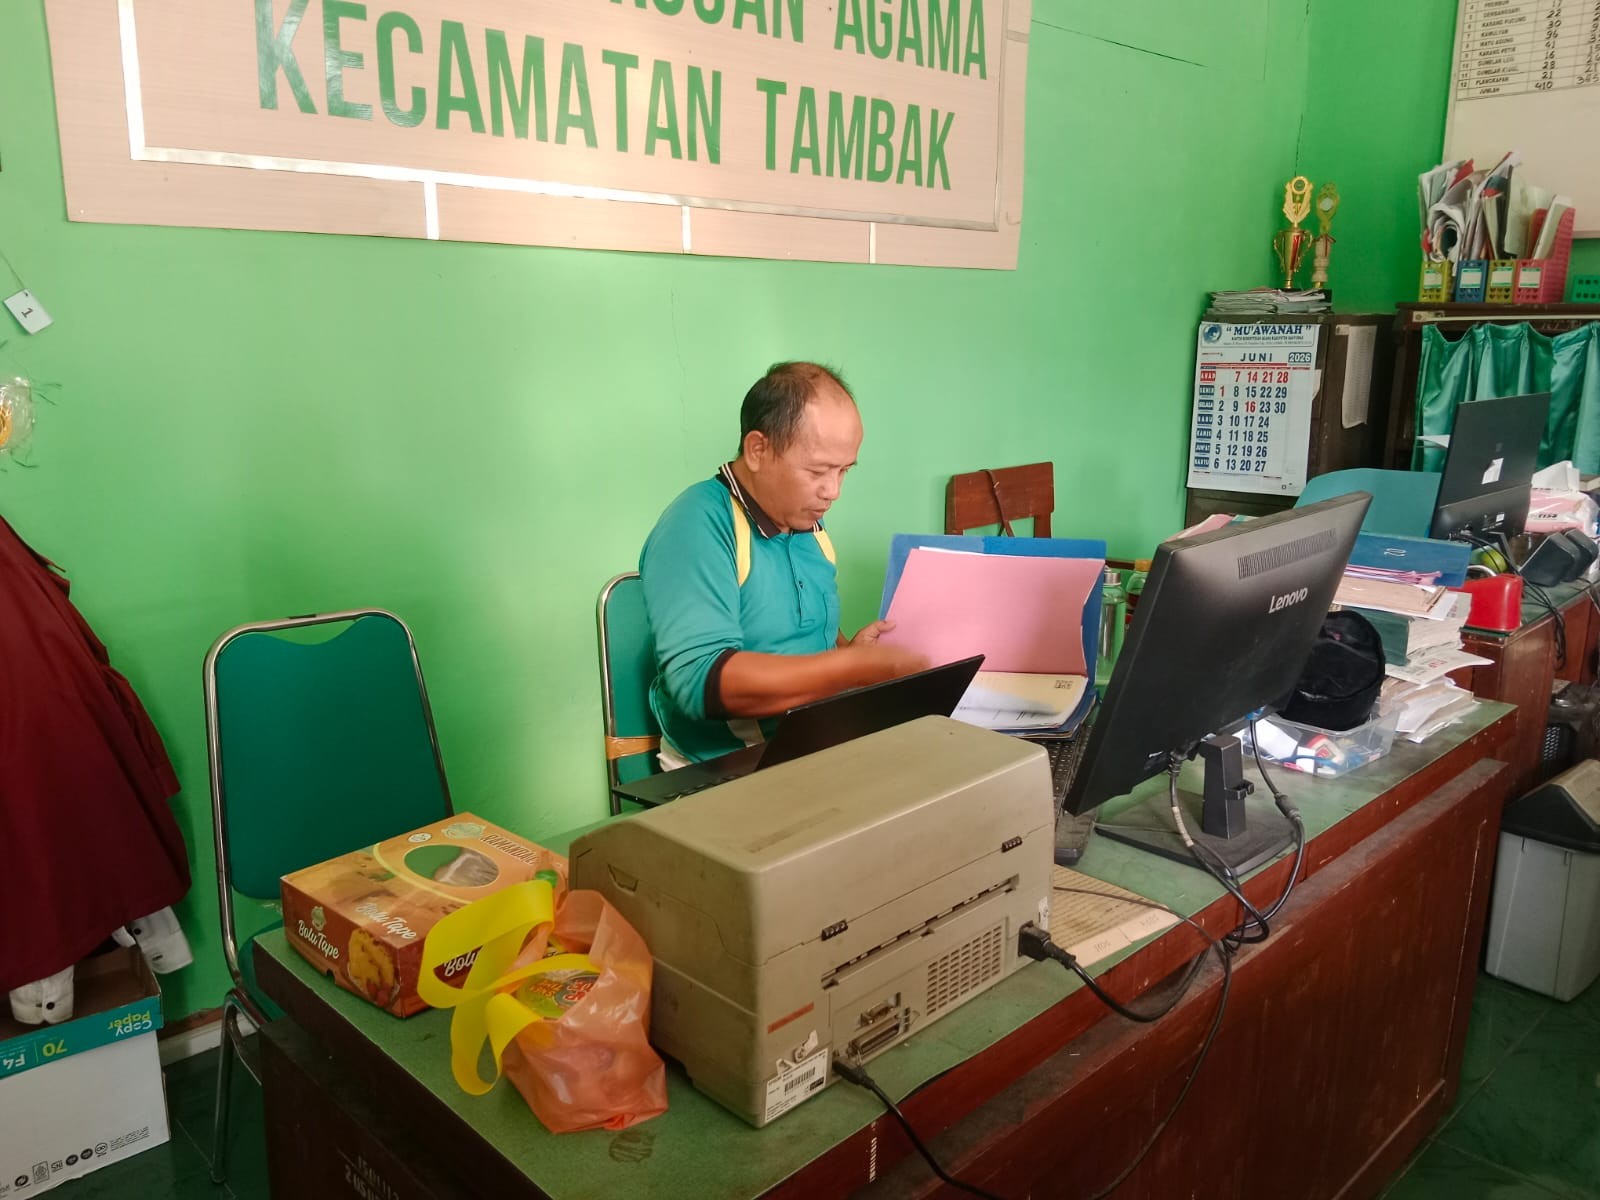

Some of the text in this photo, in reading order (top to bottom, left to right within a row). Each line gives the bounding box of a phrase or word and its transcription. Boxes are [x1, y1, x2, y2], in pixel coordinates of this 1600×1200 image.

[834, 0, 987, 80] AGAMA
[254, 0, 955, 191] KECAMATAN TAMBAK
[1240, 352, 1312, 362] JUNI 2026
[1235, 371, 1240, 383] 7
[1248, 371, 1258, 383] 14
[1262, 372, 1273, 383] 21
[1277, 372, 1288, 383] 28
[1220, 386, 1224, 397] 1
[1234, 386, 1239, 397] 8
[1246, 386, 1256, 398] 15
[1260, 387, 1271, 398] 22
[1275, 387, 1287, 398] 29
[1218, 400, 1224, 412] 2
[1233, 401, 1238, 412] 9
[1245, 401, 1256, 413] 16
[1259, 402, 1270, 413] 23
[1274, 402, 1286, 414] 30
[1217, 415, 1223, 426] 3
[1230, 415, 1240, 427] 10
[1244, 416, 1254, 427] 17
[1258, 417, 1269, 428] 24
[1216, 429, 1222, 440] 4
[1229, 430, 1239, 441] 11
[1243, 430, 1253, 442] 18
[1257, 431, 1268, 443] 25
[1215, 444, 1220, 455] 5
[1227, 445, 1238, 456] 12
[1242, 445, 1252, 457] 19
[1256, 446, 1267, 457] 26
[1214, 458, 1219, 468] 6
[1226, 459, 1236, 470] 13
[1240, 460, 1251, 471] 20
[1254, 460, 1266, 472] 27
[1268, 587, 1308, 614] Lenovo
[356, 902, 416, 939] Bolu Tape
[298, 920, 340, 959] Bolu Tape
[108, 1010, 151, 1030] Paper
[115, 1020, 152, 1036] Copy
[42, 1040, 68, 1056] 70
[2, 1054, 26, 1070] F4
